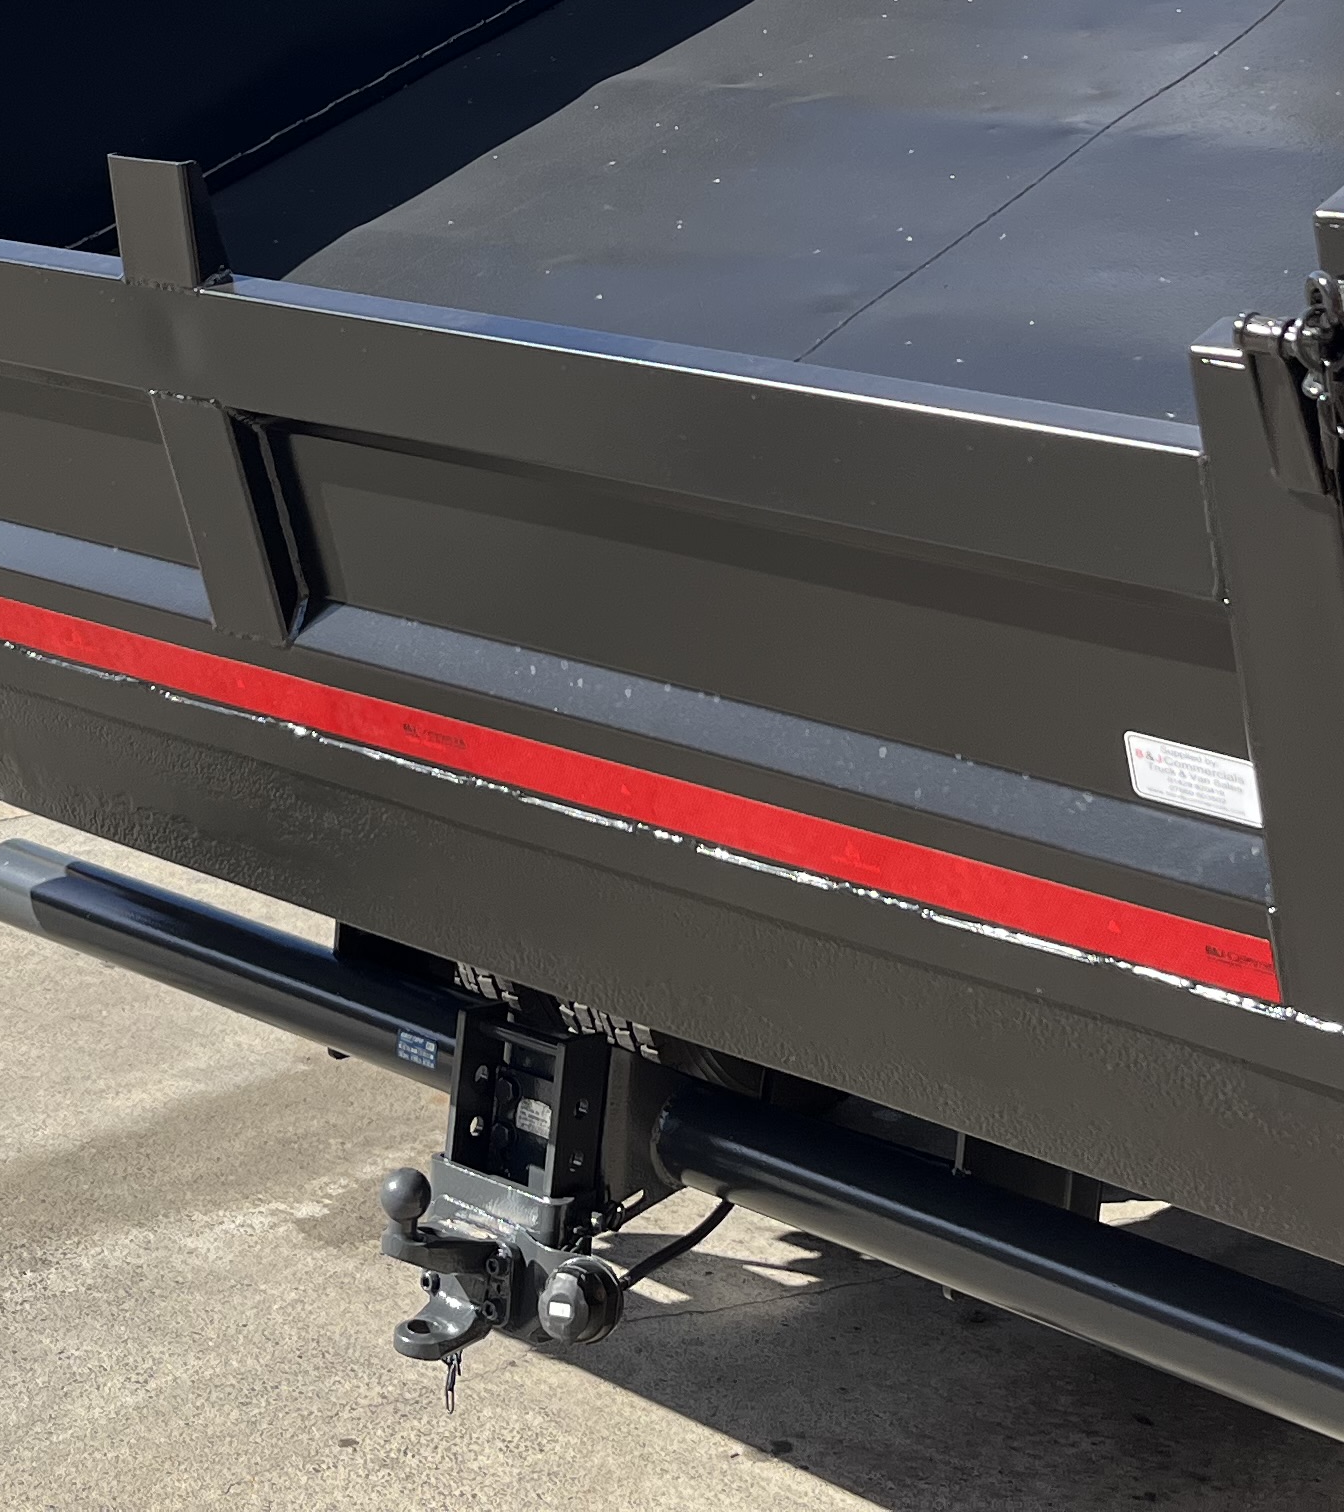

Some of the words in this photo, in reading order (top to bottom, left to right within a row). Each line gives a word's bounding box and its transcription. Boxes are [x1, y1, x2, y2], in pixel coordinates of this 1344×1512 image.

[1135, 748, 1144, 759] B
[1163, 755, 1245, 783] Commercials
[1160, 745, 1202, 763] Supplied
[1148, 761, 1176, 776] Truck
[1189, 772, 1211, 784] Van
[1212, 778, 1243, 793] Sales
